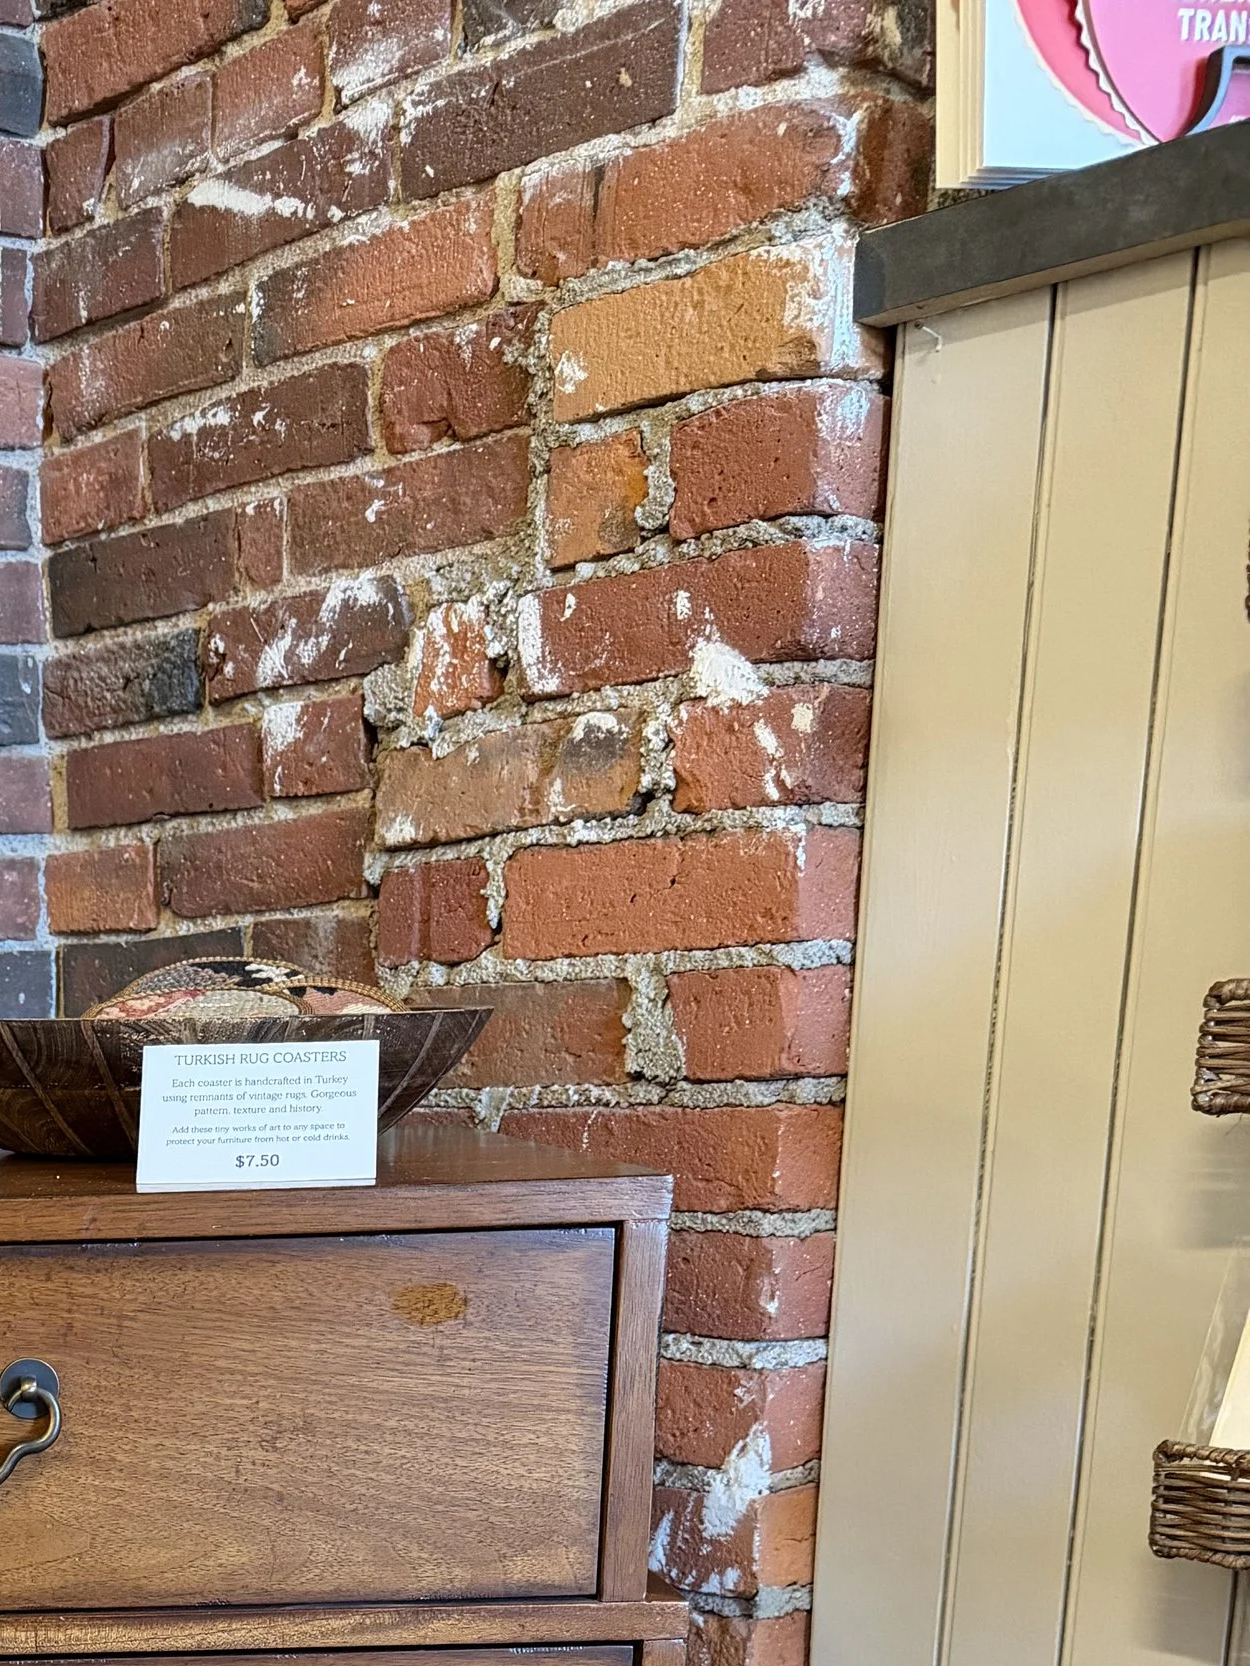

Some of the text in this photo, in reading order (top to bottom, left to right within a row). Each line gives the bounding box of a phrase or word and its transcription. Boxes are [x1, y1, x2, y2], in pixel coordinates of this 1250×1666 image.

[1178, 7, 1250, 44] TRAN
[174, 1050, 347, 1066] TURKISH RUG COASTERS
[171, 1074, 349, 1088] Each coaster is handcrafted in Turkey
[162, 1089, 358, 1104] using remnants of vintage rugs. Gorgeous
[233, 1106, 267, 1114] texture
[269, 1105, 287, 1113] and
[172, 1126, 190, 1134] Add
[191, 1125, 213, 1133] these
[215, 1125, 231, 1134] tiny
[232, 1124, 257, 1132] works
[282, 1123, 292, 1131] to
[293, 1123, 309, 1132] any
[310, 1122, 335, 1131] space
[336, 1122, 345, 1130] to
[166, 1138, 196, 1147] protect
[197, 1137, 216, 1146] your
[217, 1136, 253, 1144] furniture
[254, 1135, 274, 1143] from
[303, 1134, 322, 1142] cold
[323, 1133, 350, 1141] drinks.
[235, 1154, 280, 1168] $7.50
